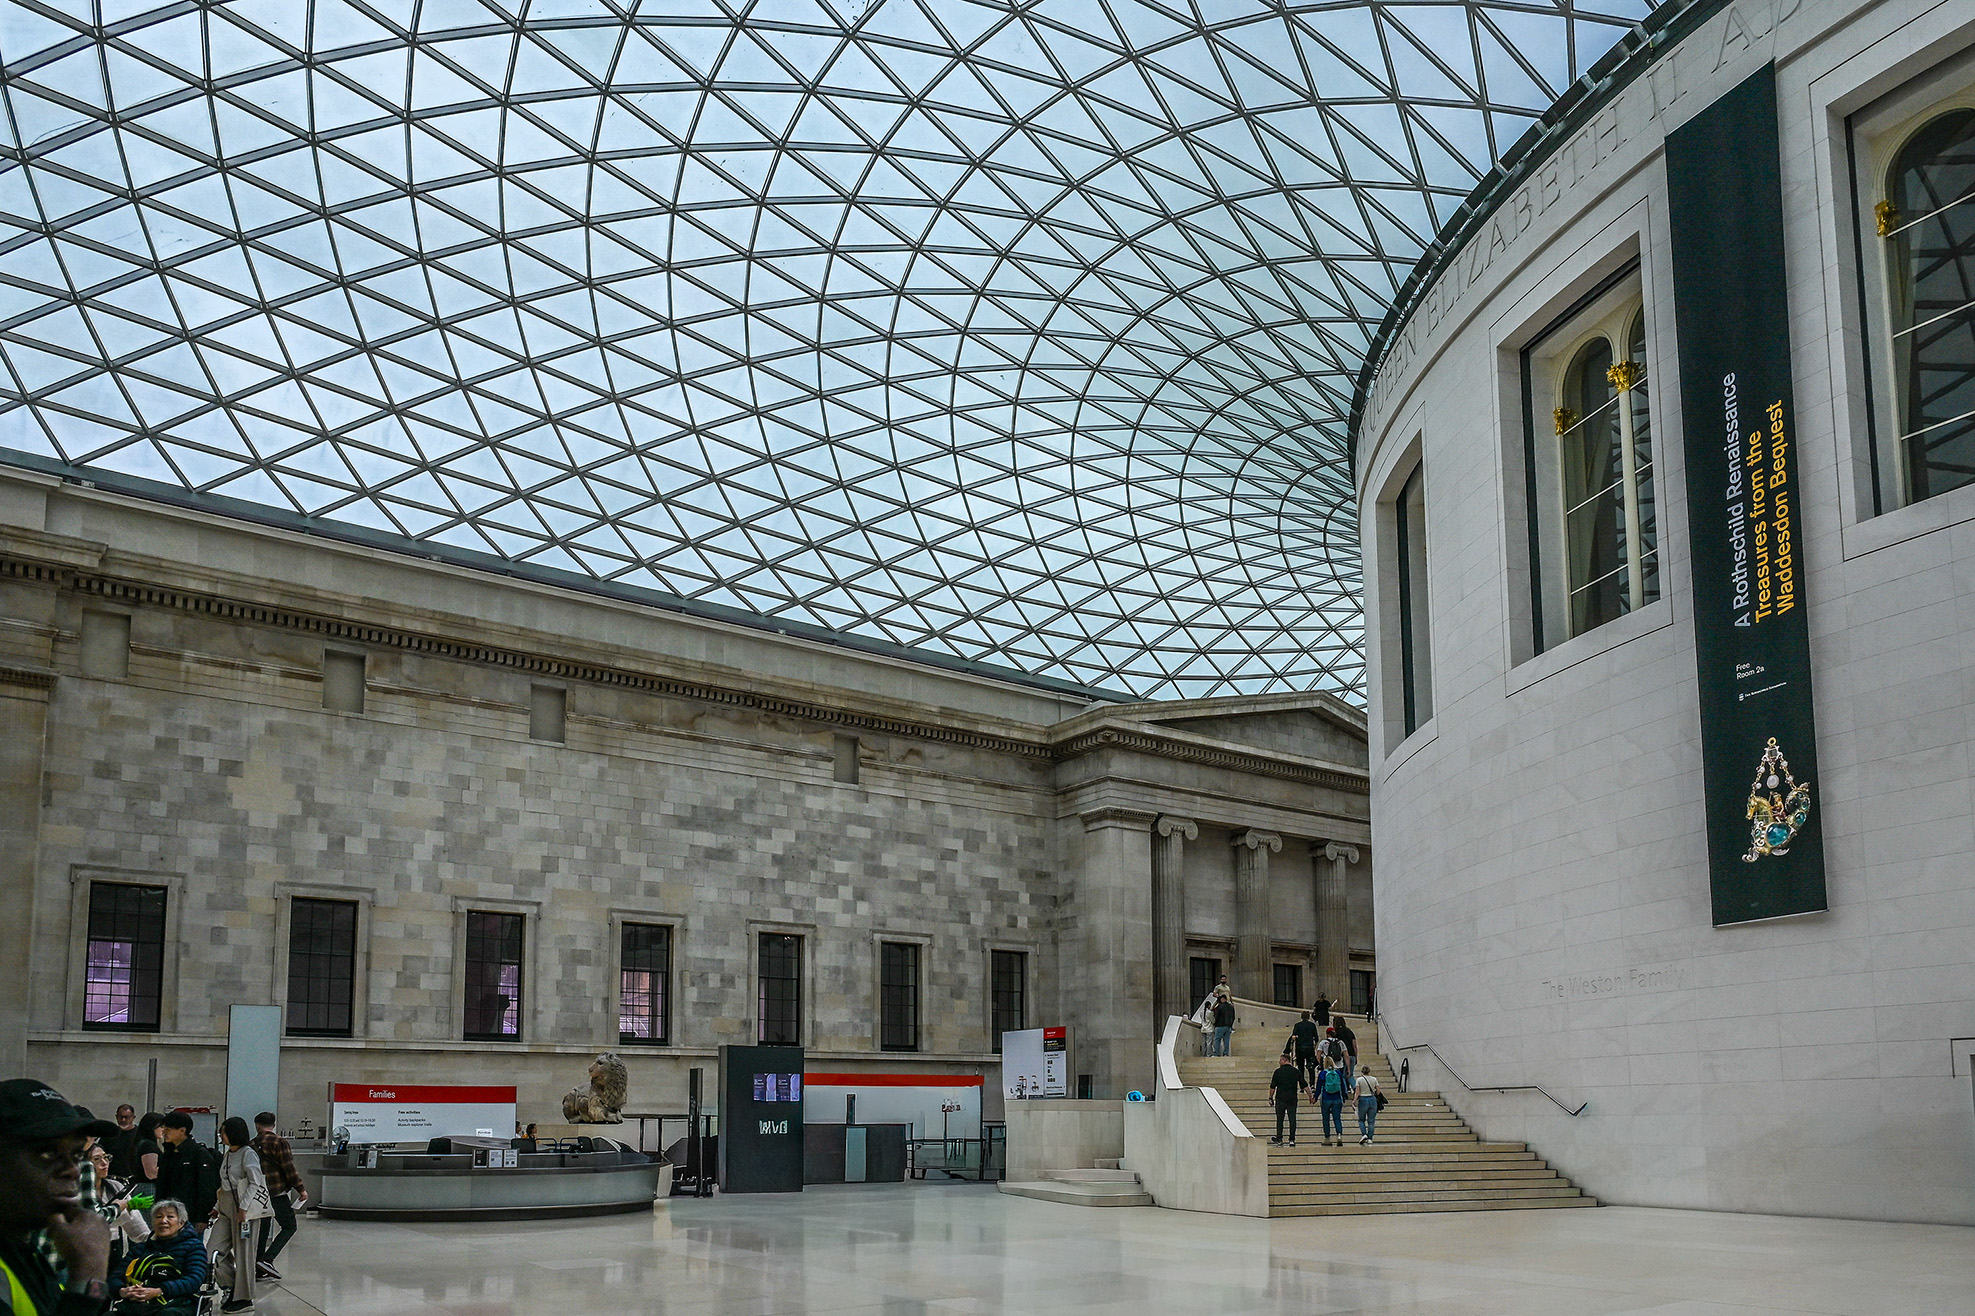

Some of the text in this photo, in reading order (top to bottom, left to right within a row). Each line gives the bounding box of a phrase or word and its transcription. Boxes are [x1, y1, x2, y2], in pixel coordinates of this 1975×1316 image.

[1425, 96, 1628, 339] ELIZABETH
[1645, 46, 1688, 122] II
[1723, 372, 1751, 627] A Rothschild Renaissance
[1746, 430, 1772, 623] Treasures from the
[1766, 399, 1795, 616] Waddesdon Bequest
[1735, 662, 1751, 672] Free
[1736, 665, 1765, 680] Room 2a
[1541, 965, 1684, 1000] The Weston Family
[368, 1089, 396, 1099] Families
